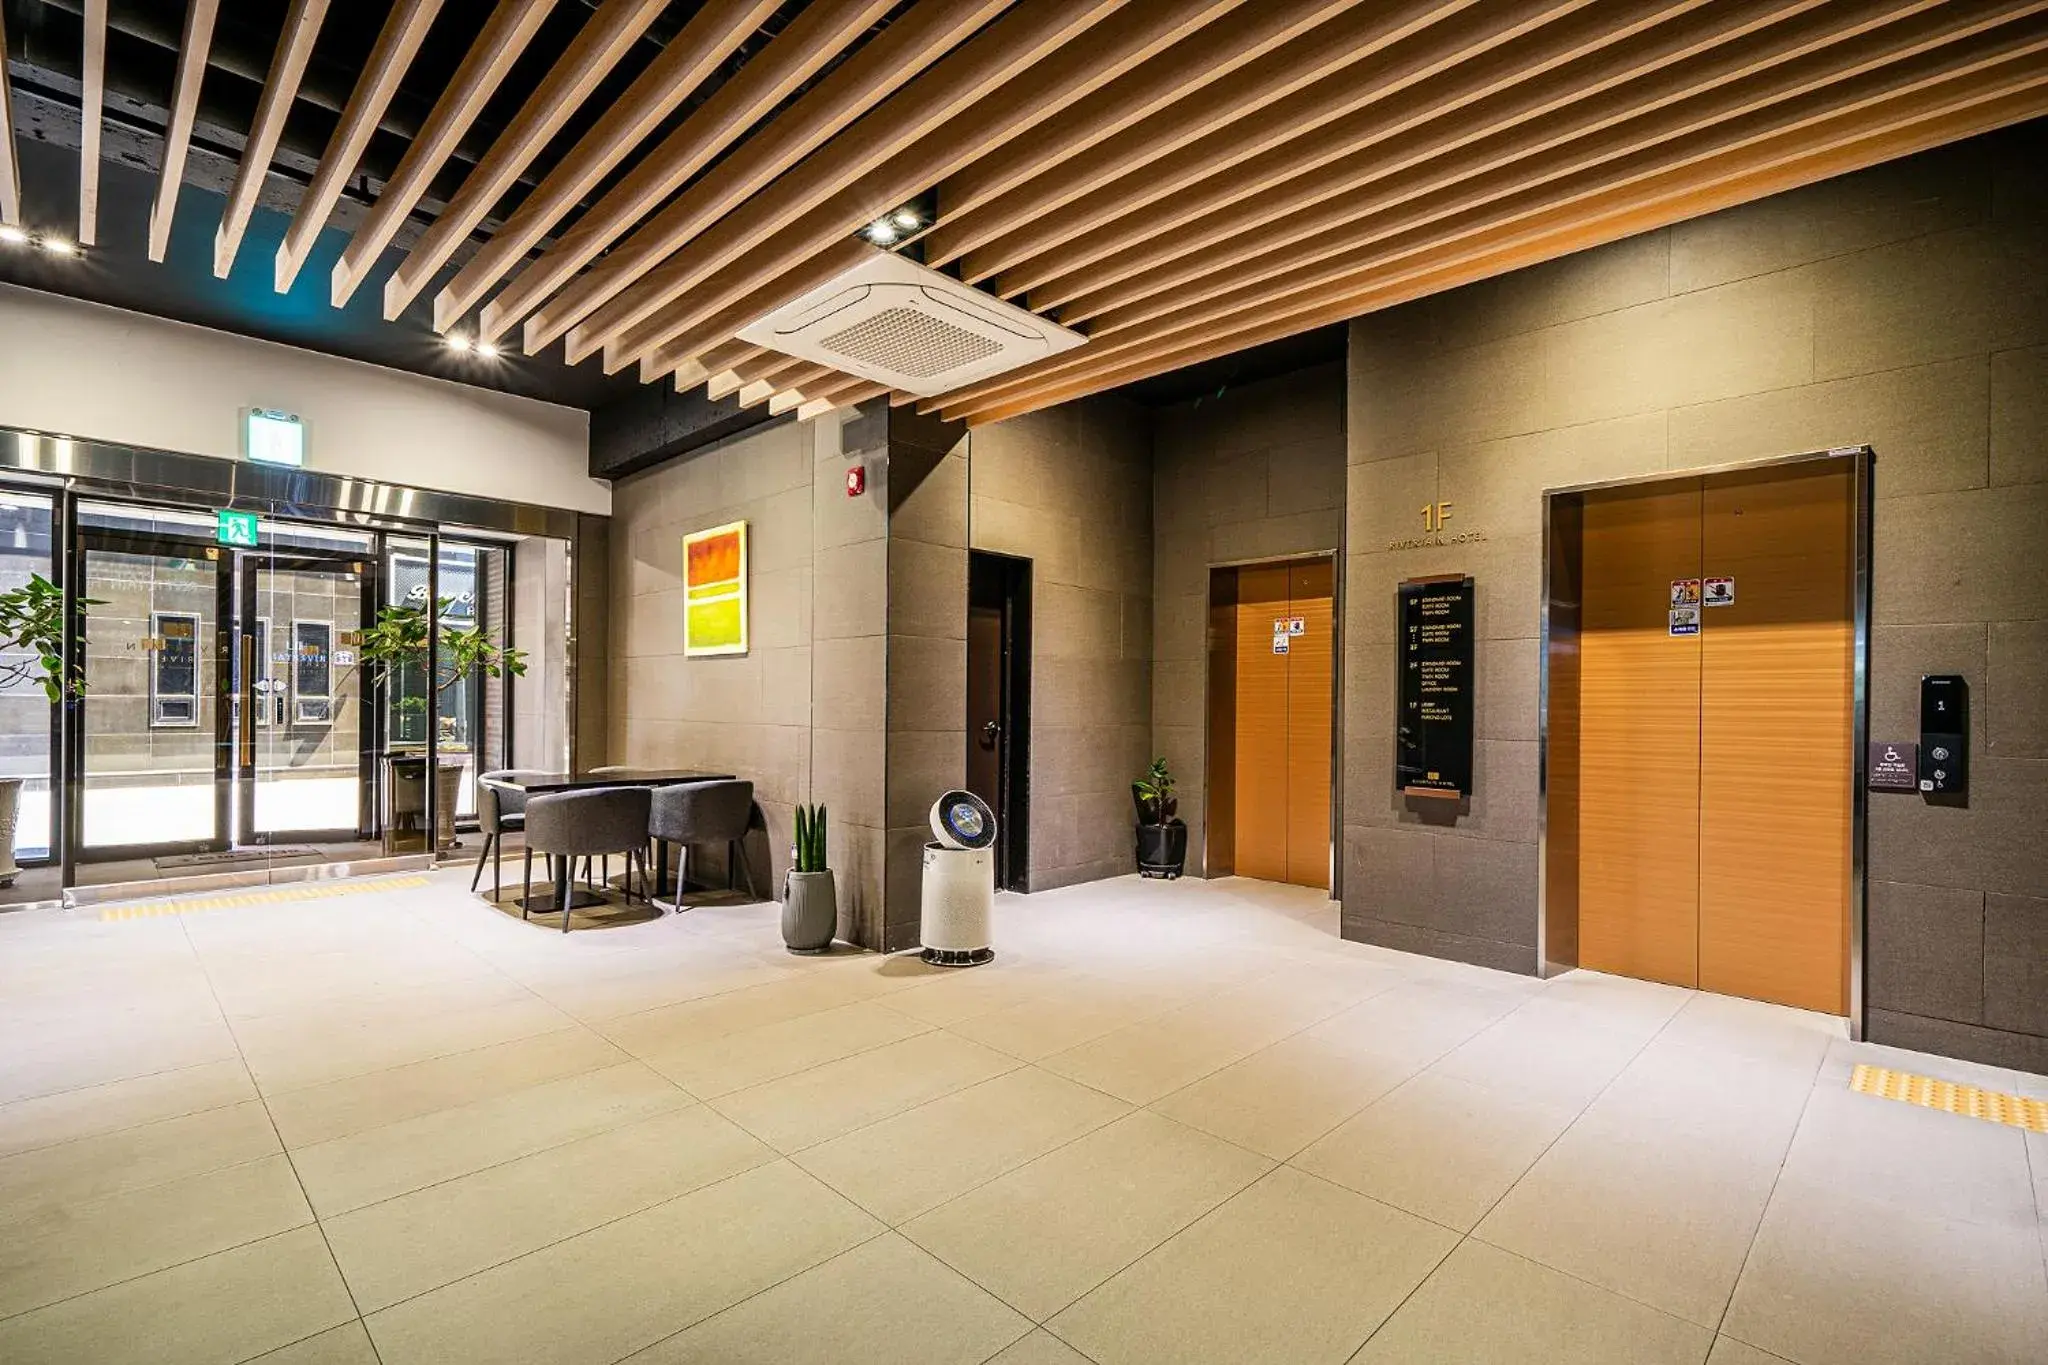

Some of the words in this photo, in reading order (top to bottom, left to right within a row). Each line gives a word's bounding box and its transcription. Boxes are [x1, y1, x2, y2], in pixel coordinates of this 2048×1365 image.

[1420, 501, 1453, 532] 1F
[1450, 530, 1488, 545] HOTEL
[1937, 700, 1945, 711] 1
